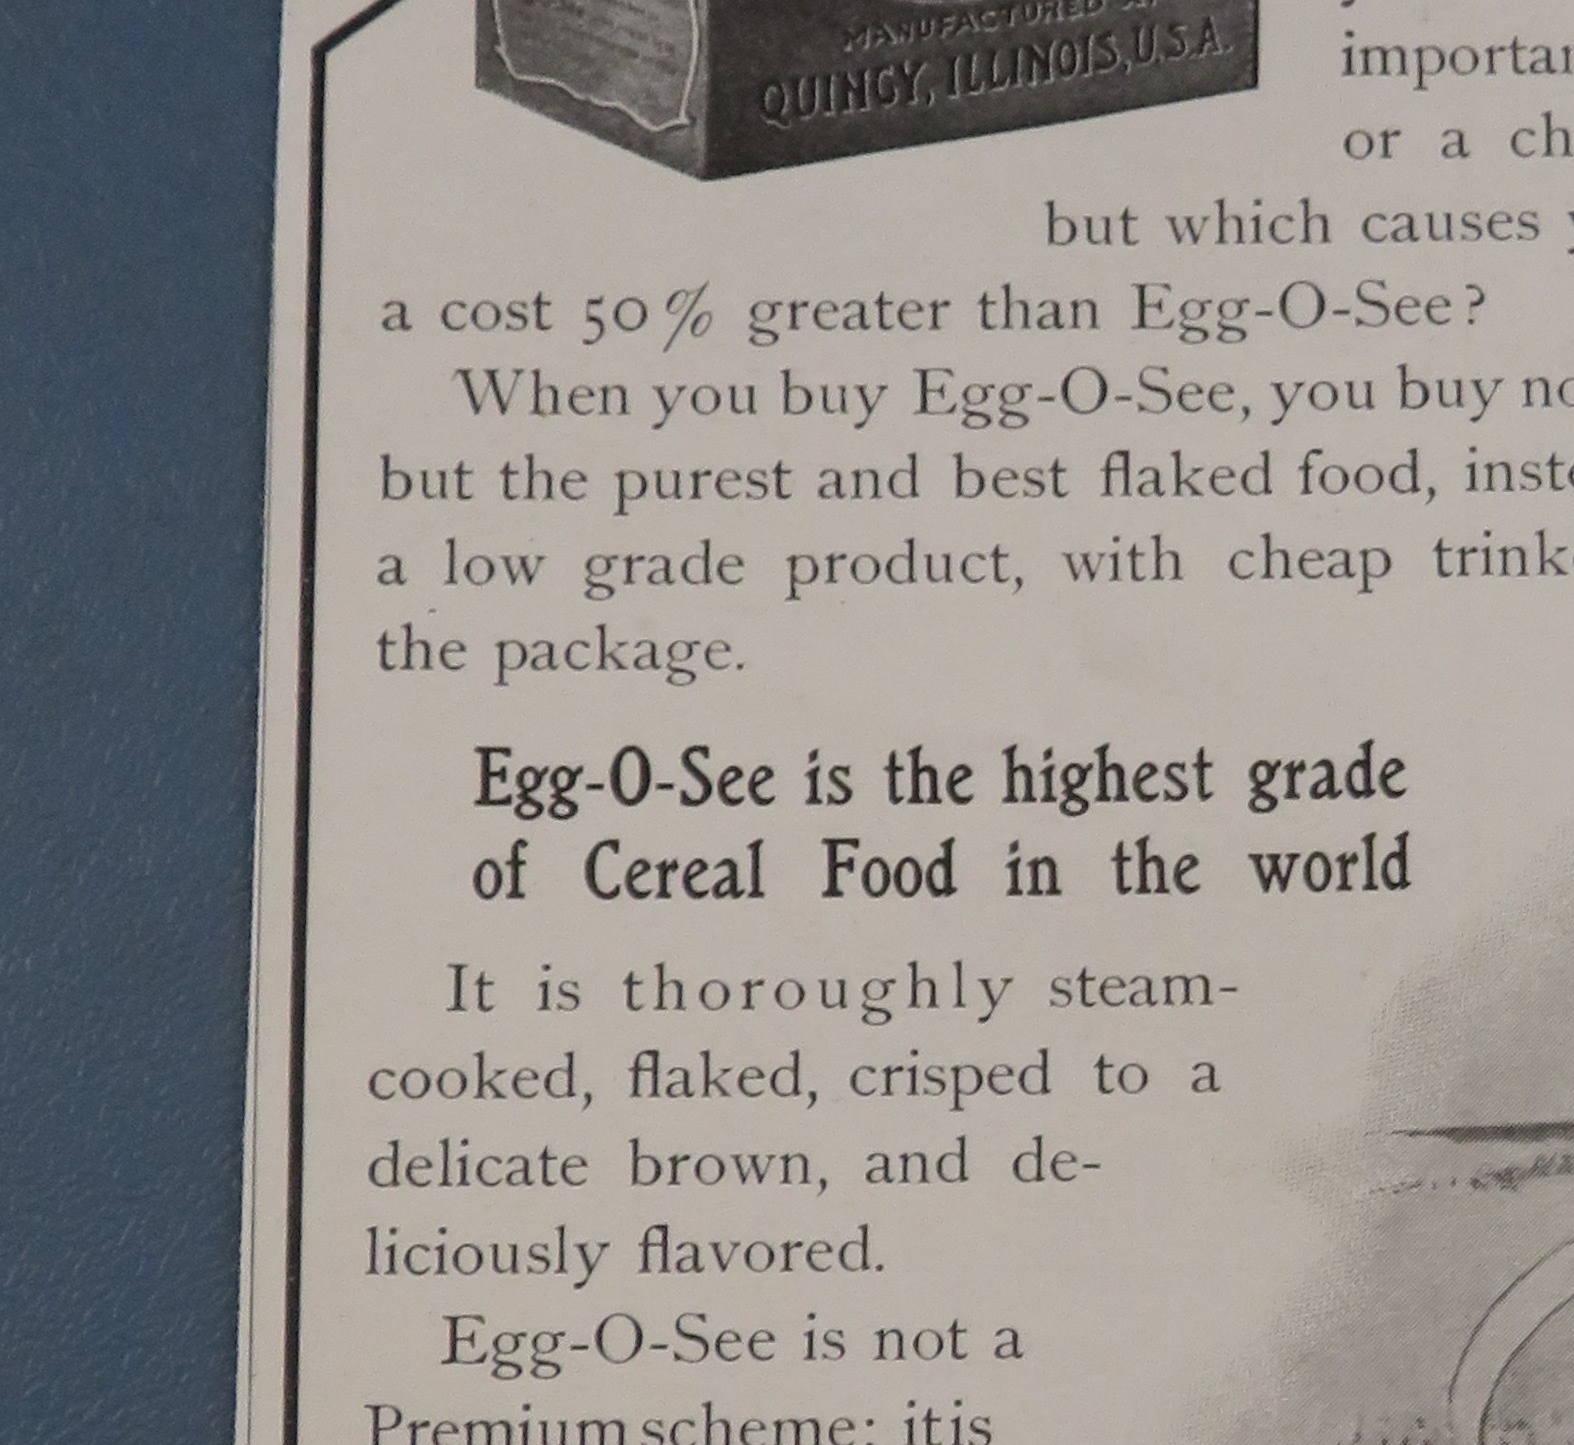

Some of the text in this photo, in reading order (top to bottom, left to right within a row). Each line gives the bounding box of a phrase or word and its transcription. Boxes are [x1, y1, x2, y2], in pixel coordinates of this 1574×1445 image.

[453, 368, 630, 417] When
[652, 385, 757, 430] you
[781, 369, 888, 430] buy
[913, 366, 1251, 430] Egg-O-See,
[1270, 381, 1375, 426] you
[1397, 363, 1504, 423] buy
[377, 554, 407, 586] a
[444, 537, 546, 586] low
[584, 538, 744, 601] grade
[785, 537, 1023, 601] product,
[1062, 534, 1183, 582] with
[1228, 532, 1392, 594] cheap
[377, 622, 744, 686] the package.
[473, 738, 1407, 821] Egg-O-See is the highest grade
[473, 830, 1412, 901] of Cereal Food in the world
[446, 960, 1238, 1026] It is thoroughly steam-
[368, 1048, 1221, 1112] cooked, flaked, crisped to a
[365, 1223, 884, 1290] liciously flavored.
[441, 1312, 1024, 1380] Egg-O-See is not a
